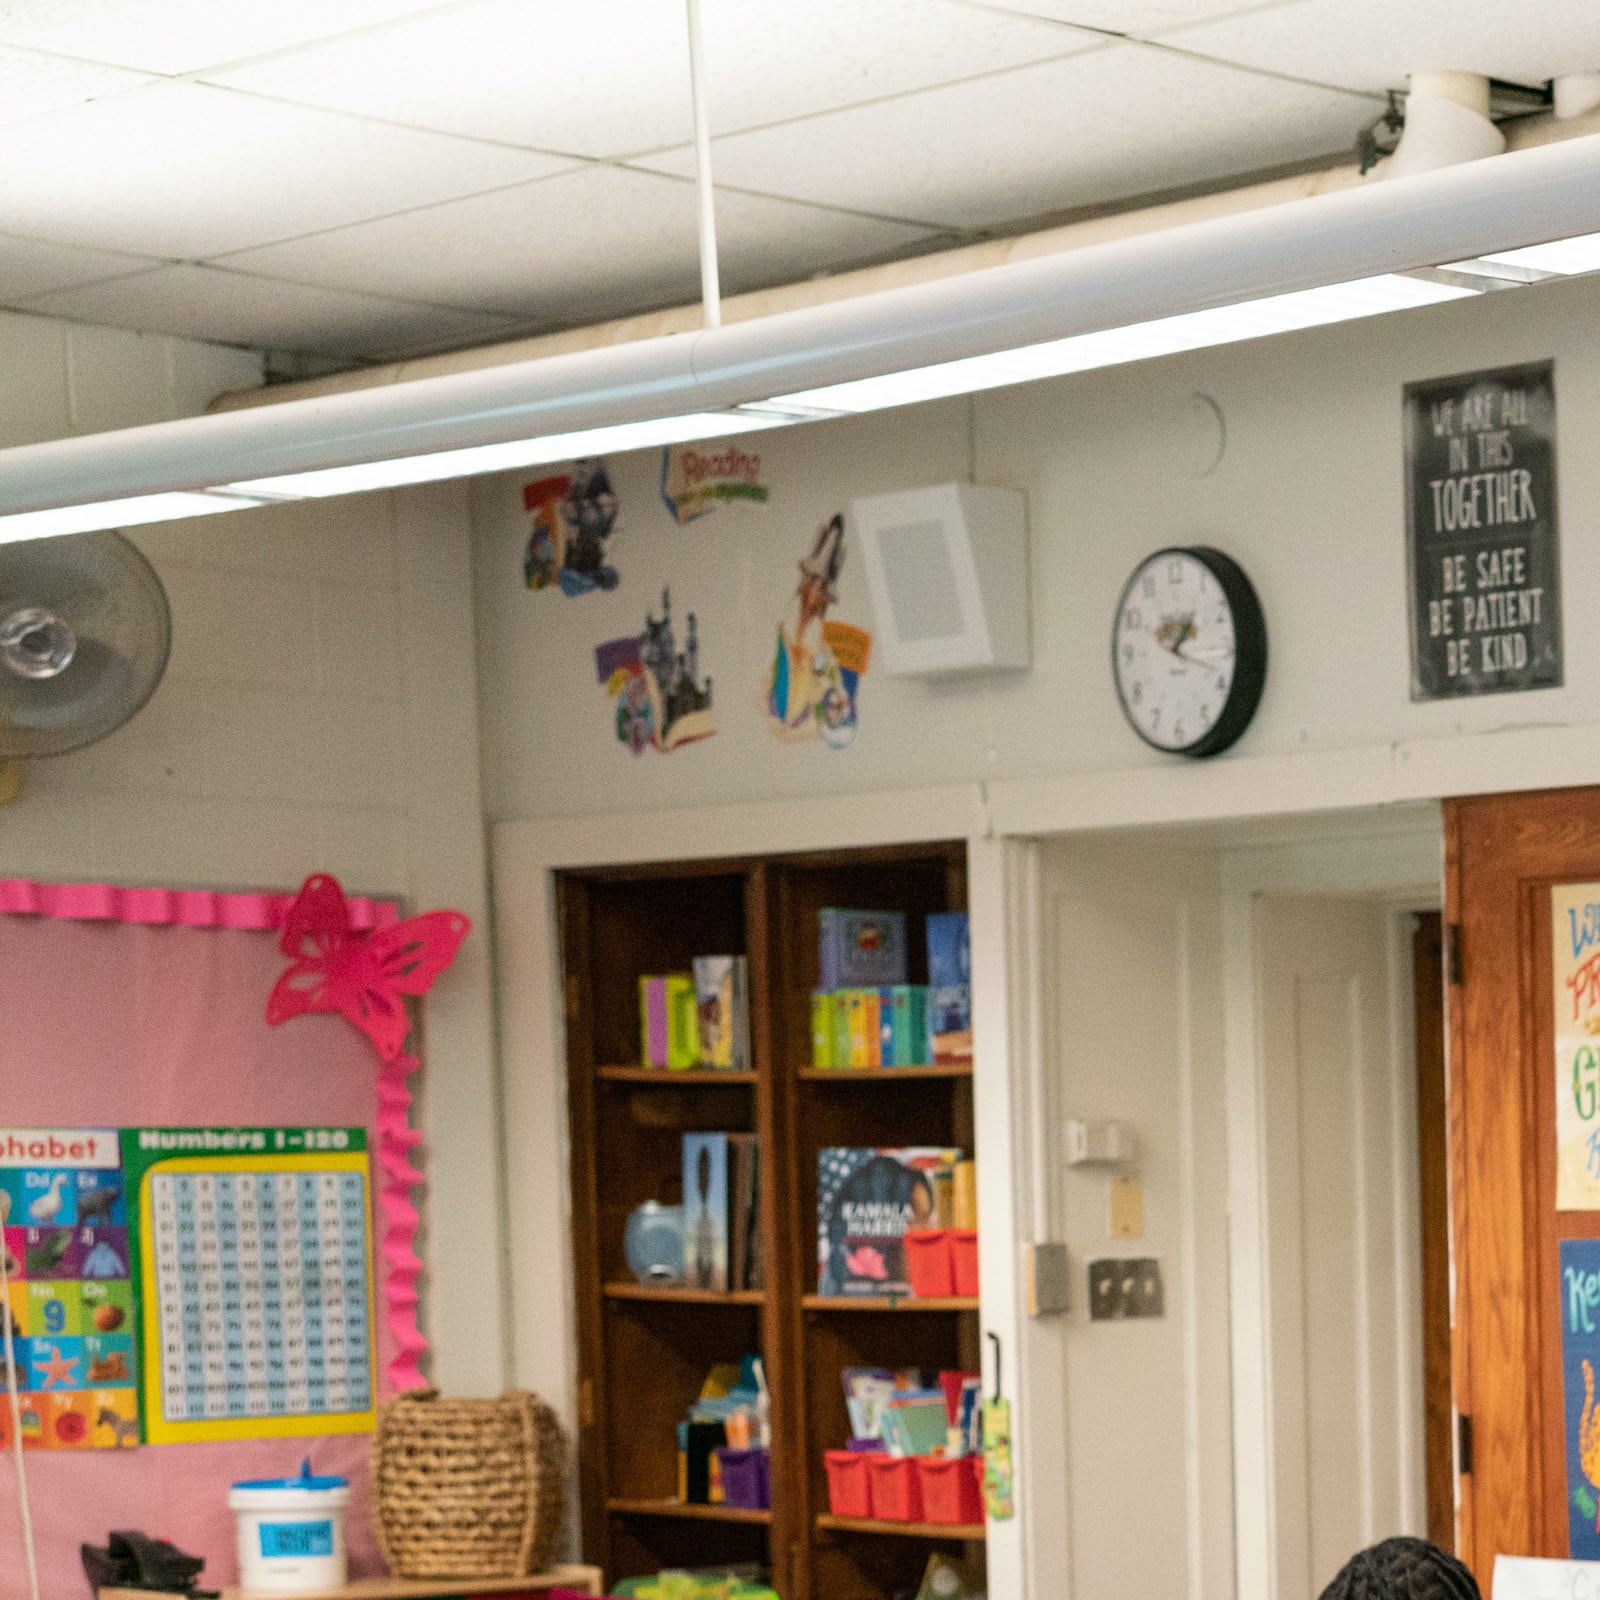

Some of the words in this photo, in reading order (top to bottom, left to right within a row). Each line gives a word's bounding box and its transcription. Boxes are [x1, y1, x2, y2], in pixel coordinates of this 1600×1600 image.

[1429, 468, 1537, 533] TOGETHER
[1443, 555, 1466, 593] BE
[1477, 548, 1525, 588] SAFE
[1429, 599, 1452, 637] BE
[1464, 588, 1544, 633] PATIENT
[1447, 639, 1471, 677] BE
[1482, 633, 1527, 673] KIND
[0, 1137, 98, 1162] habet
[139, 1132, 264, 1151] Numbers
